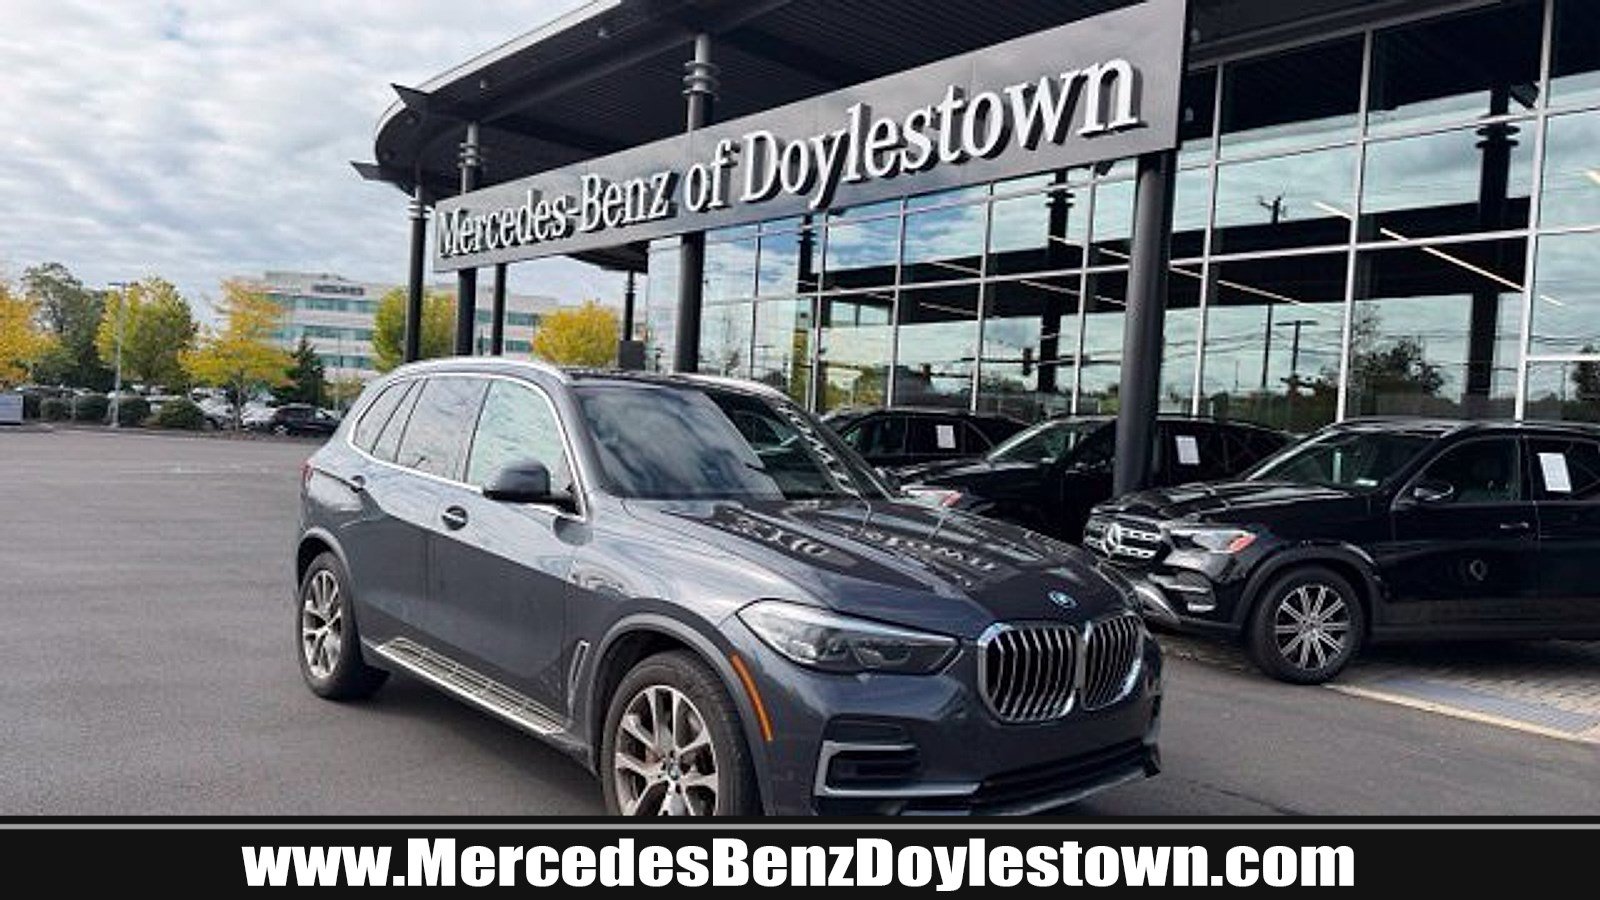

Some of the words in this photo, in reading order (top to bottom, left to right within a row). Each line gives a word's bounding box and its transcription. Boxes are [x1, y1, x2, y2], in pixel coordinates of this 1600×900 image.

[436, 172, 669, 258] Mercedes-Benz
[685, 138, 731, 211] of
[740, 58, 1139, 209] Doylestown
